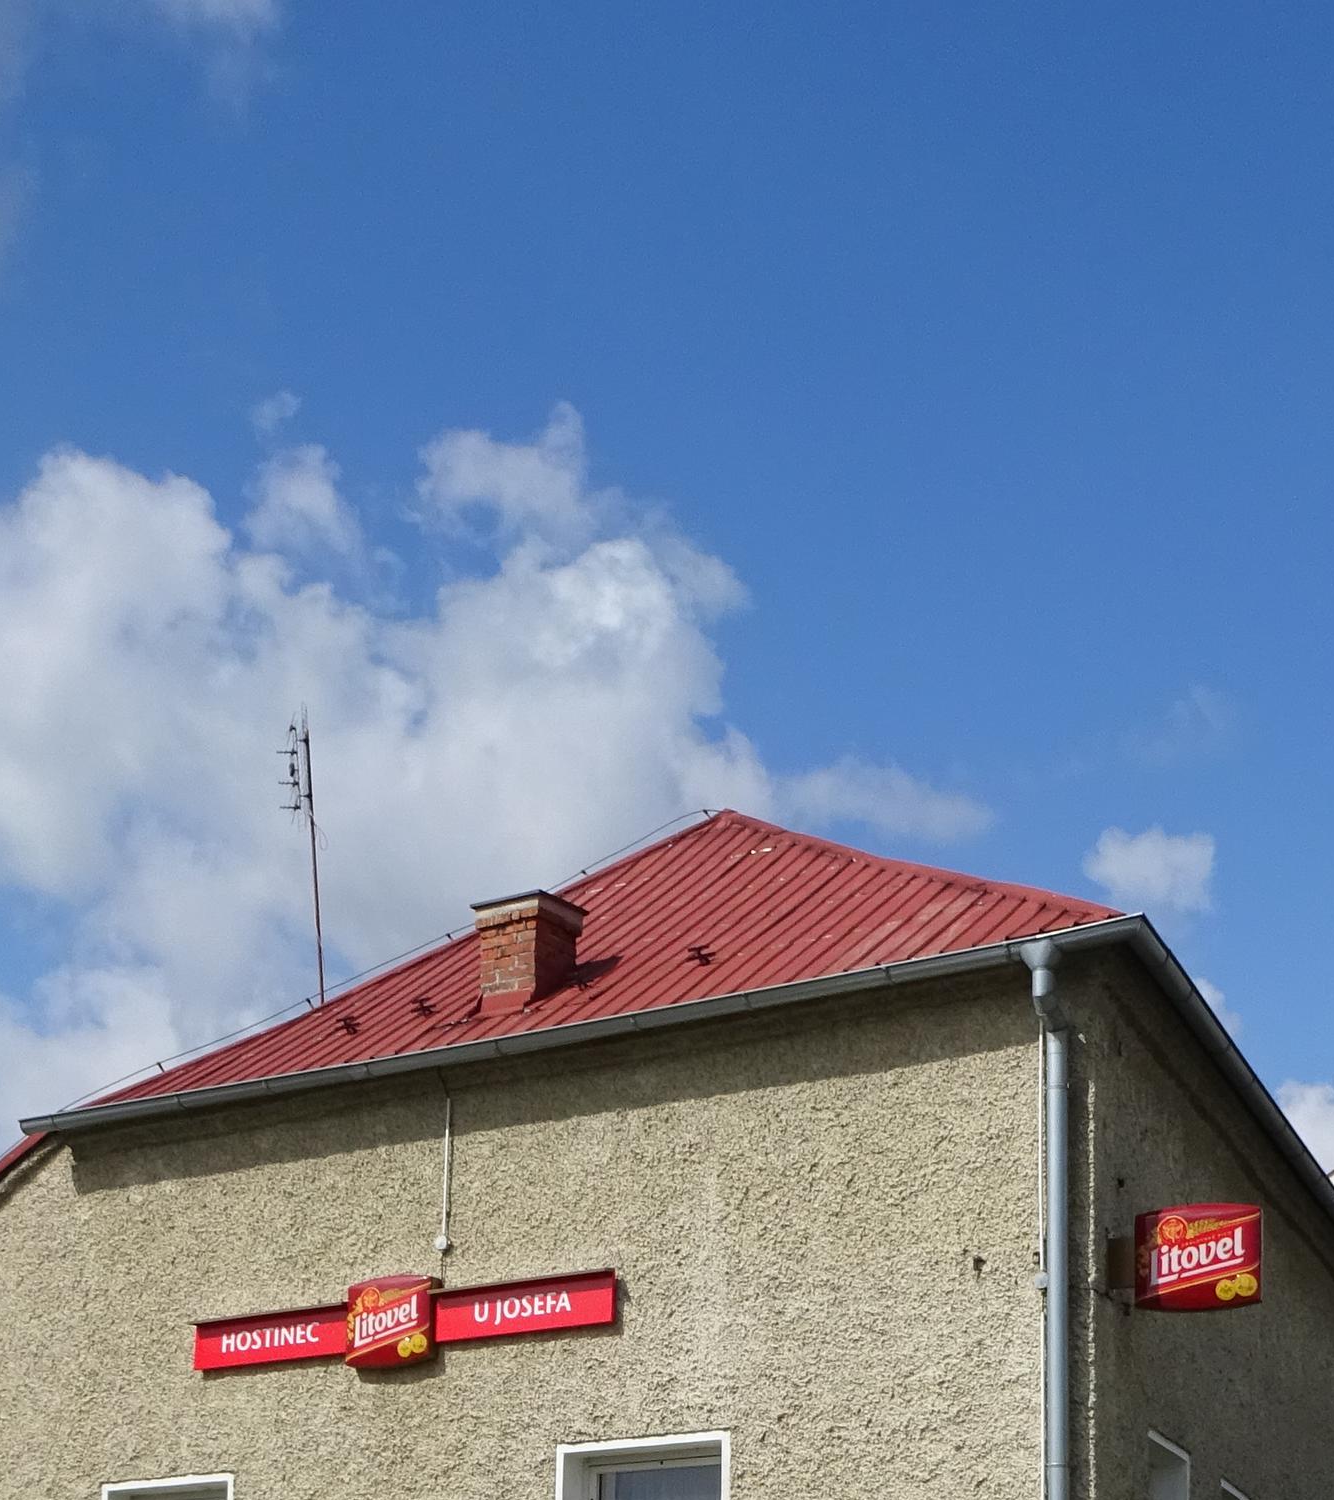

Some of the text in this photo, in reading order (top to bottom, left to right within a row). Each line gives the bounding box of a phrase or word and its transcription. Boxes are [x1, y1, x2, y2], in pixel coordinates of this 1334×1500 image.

[1150, 1227, 1245, 1286] Litovel
[354, 1294, 419, 1348] Litovel
[474, 1291, 572, 1325] U JOSEFA
[220, 1321, 321, 1354] HOSTINEC
